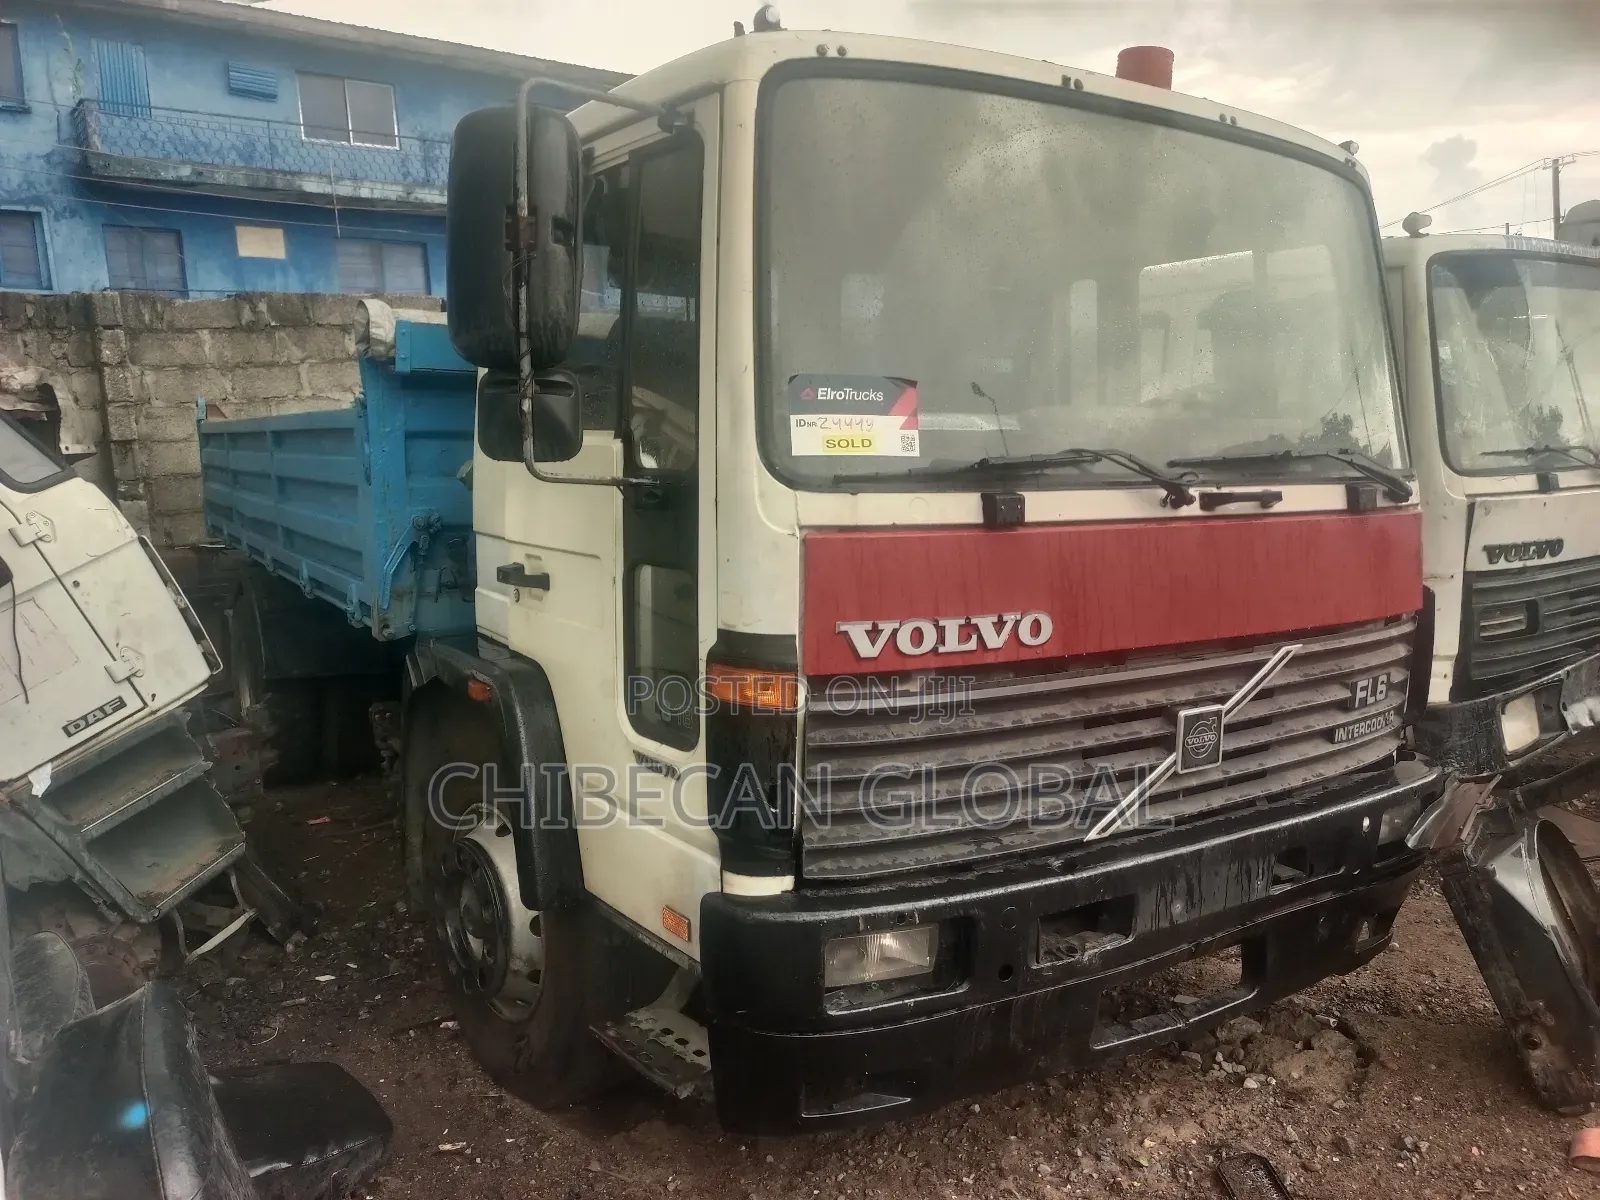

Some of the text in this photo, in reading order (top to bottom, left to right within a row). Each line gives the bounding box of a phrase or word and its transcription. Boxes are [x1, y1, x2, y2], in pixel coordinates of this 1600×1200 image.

[817, 387, 884, 402] ElroTrucks
[825, 438, 873, 449] SOLD
[1481, 536, 1564, 565] VOLVO
[836, 611, 1054, 659] VOLVO
[1354, 674, 1388, 709] FL6
[65, 698, 121, 735] DAF
[1186, 733, 1216, 746] VOLVO
